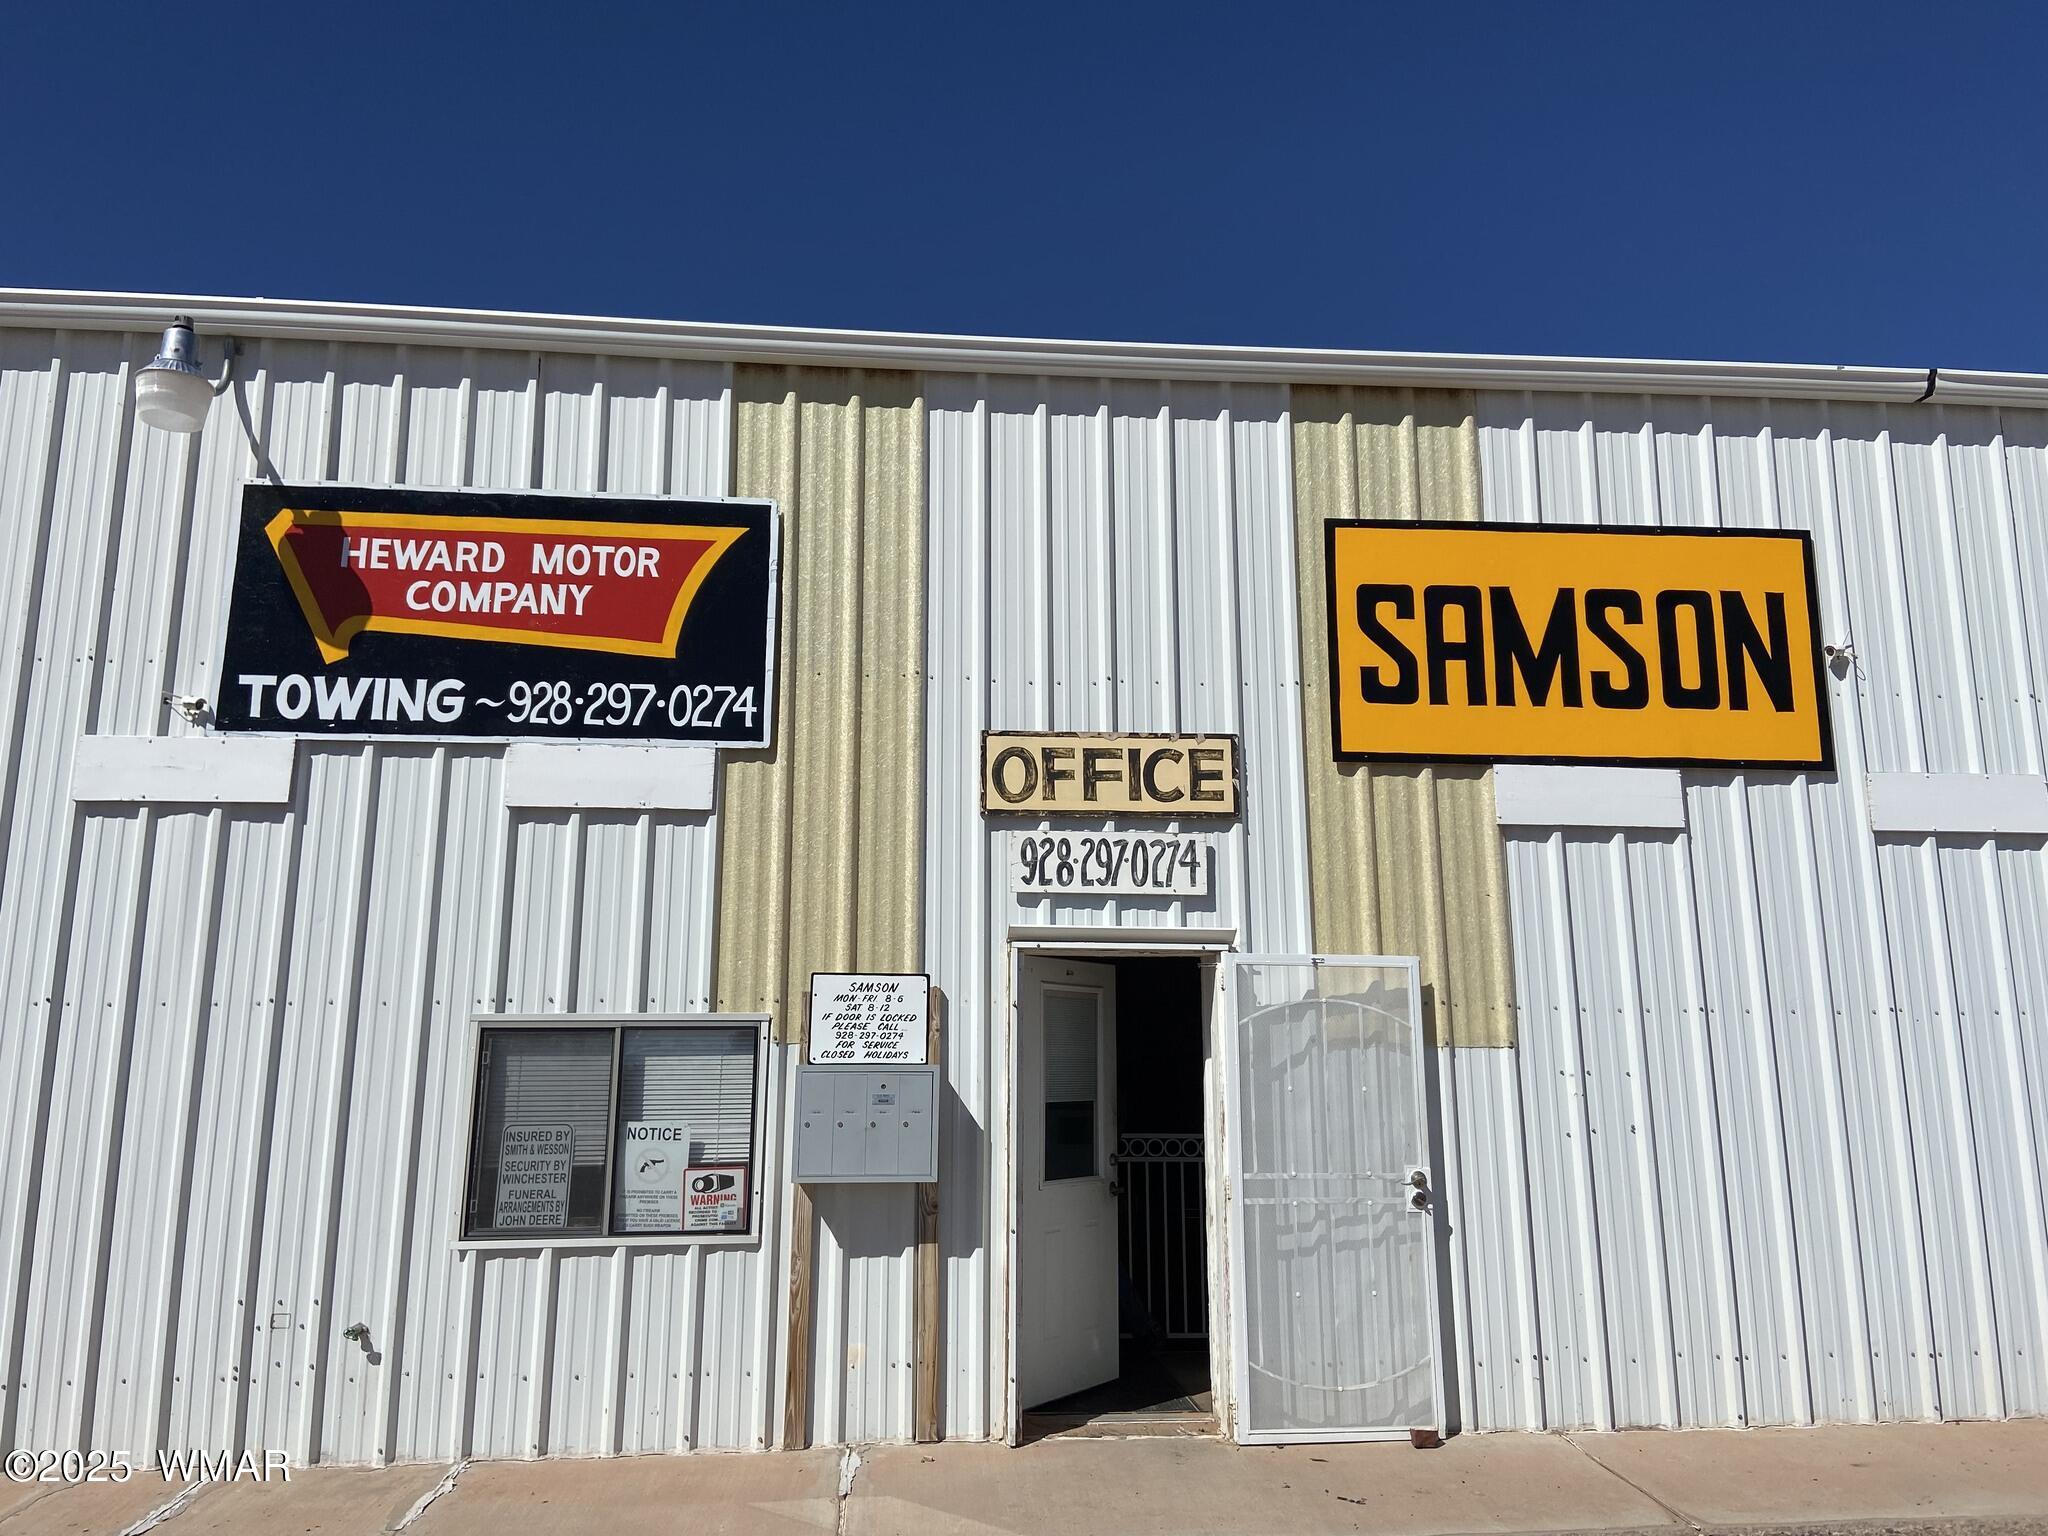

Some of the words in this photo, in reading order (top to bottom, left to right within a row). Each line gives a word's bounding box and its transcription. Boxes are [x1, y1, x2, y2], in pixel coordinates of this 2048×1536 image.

[340, 536, 505, 573] HEWARD
[531, 543, 660, 578] MOTOR
[405, 580, 593, 616] COMPANY
[1356, 584, 1795, 713] SAMSON
[238, 673, 466, 723] TOWING
[992, 746, 1224, 804] OFFICE
[848, 982, 900, 993] SAMSON
[845, 1004, 863, 1012] SAT
[821, 1013, 833, 1021] IF
[835, 1013, 862, 1021] DOOR
[866, 1013, 876, 1021] IS
[880, 1014, 917, 1022] LOCKED
[831, 1022, 871, 1031] PLEASE
[877, 1023, 899, 1031] CALL
[835, 1041, 855, 1049] FOR
[862, 1041, 900, 1049] SERVICE
[820, 1050, 855, 1059] CLOSED
[863, 1051, 909, 1059] HOLIDAYS
[506, 1131, 553, 1142] INSURED
[555, 1131, 570, 1141] BY
[627, 1127, 682, 1141] NOTICE
[505, 1144, 528, 1156] SMITH
[530, 1144, 535, 1155] &
[537, 1144, 569, 1155] WESSON
[504, 1161, 551, 1171] SECURITY
[553, 1160, 566, 1170] BY
[503, 1173, 567, 1184] WINCHESTER
[508, 1189, 557, 1200] FUNERAL
[690, 1194, 736, 1206] WARNING
[499, 1201, 553, 1213] ARRANGEMENTS
[555, 1200, 565, 1212] BY
[500, 1215, 526, 1226] JOHN
[528, 1214, 562, 1225] DEERE
